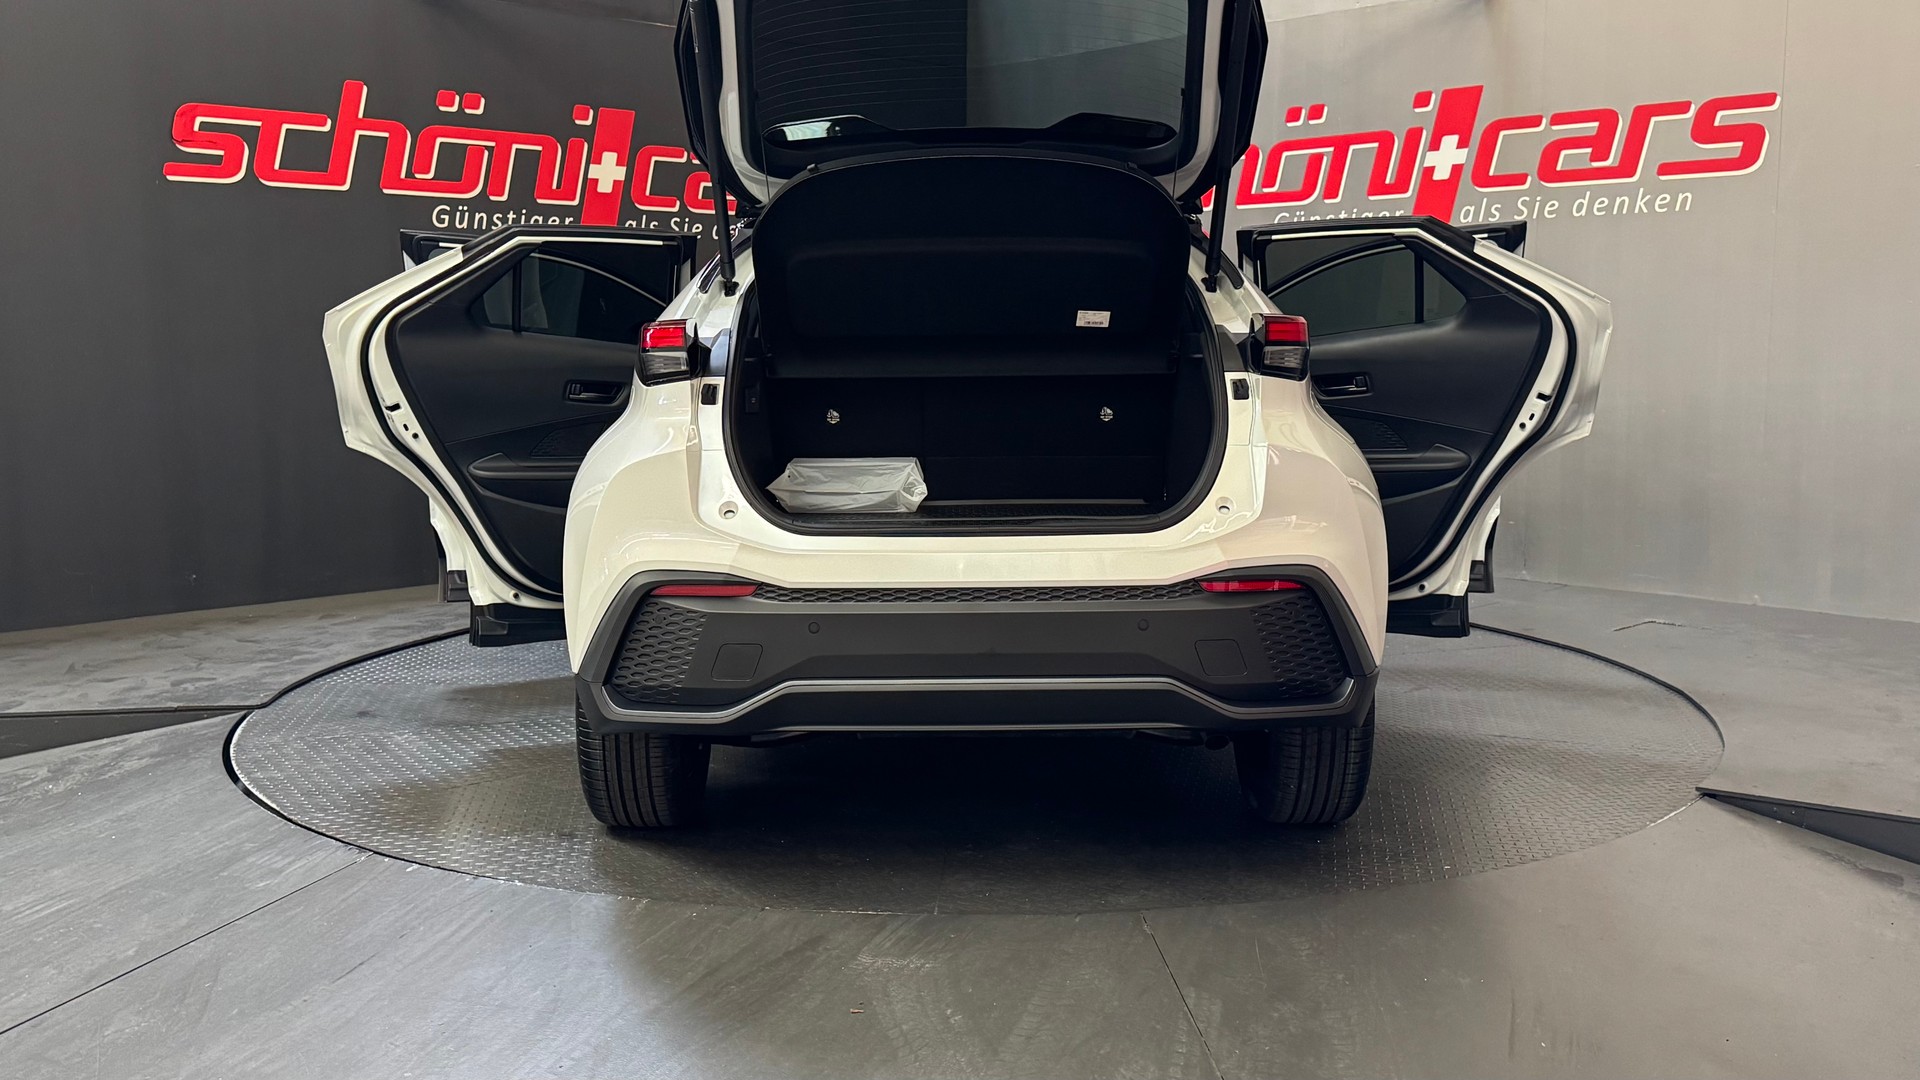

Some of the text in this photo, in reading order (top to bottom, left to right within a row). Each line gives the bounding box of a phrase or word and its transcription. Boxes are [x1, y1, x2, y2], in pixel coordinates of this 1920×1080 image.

[1459, 187, 1693, 223] als Sie denken
